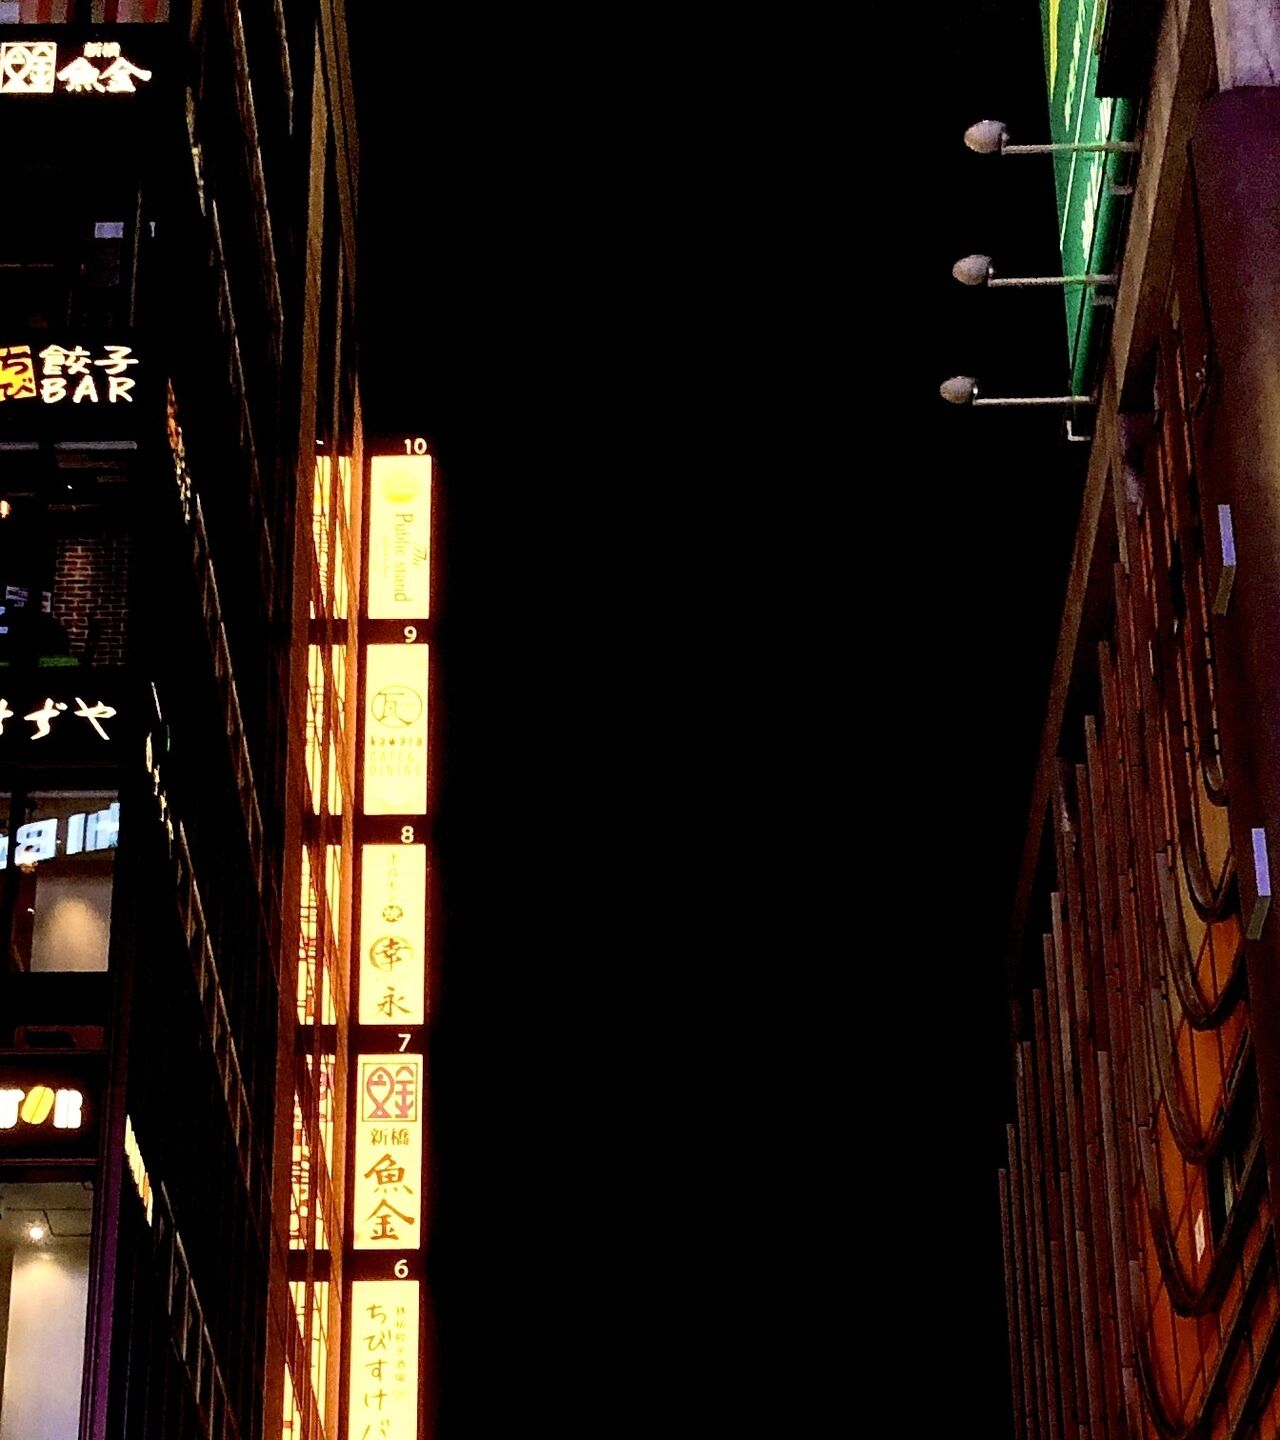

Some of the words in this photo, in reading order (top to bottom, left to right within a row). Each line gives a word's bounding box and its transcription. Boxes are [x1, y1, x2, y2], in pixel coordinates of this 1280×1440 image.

[39, 344, 139, 375] 餃子
[40, 376, 136, 403] BAR
[404, 438, 428, 455] 10
[404, 626, 417, 643] 9
[401, 826, 414, 844] 8
[398, 1034, 412, 1052] 7
[370, 1127, 410, 1146] 新橋
[364, 1153, 415, 1241] 魚金
[394, 1259, 409, 1278] 6
